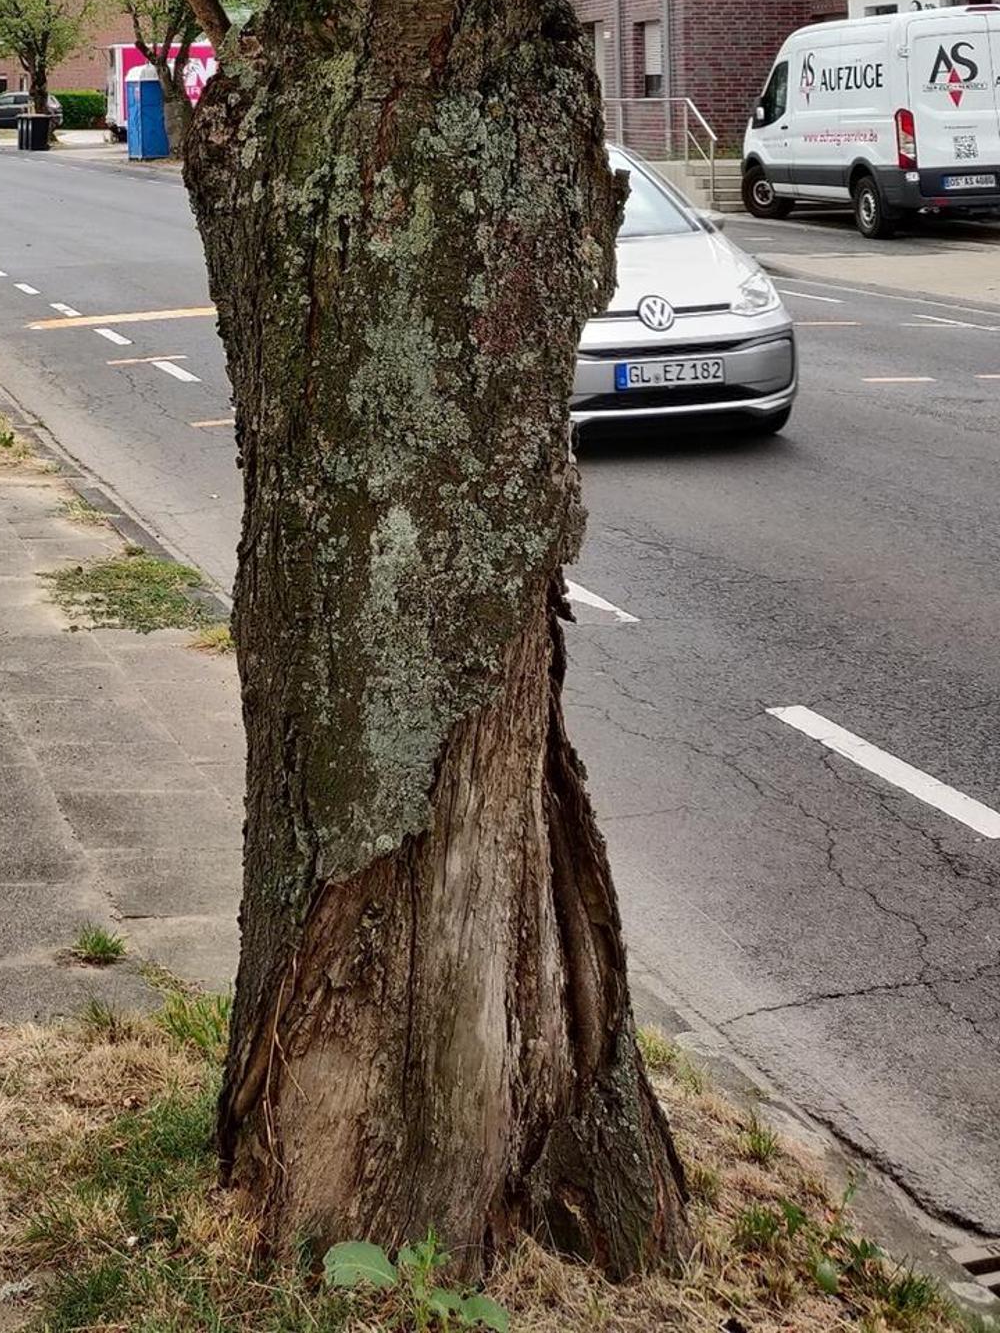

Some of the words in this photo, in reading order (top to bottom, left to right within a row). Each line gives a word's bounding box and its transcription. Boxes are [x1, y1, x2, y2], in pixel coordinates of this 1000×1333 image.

[801, 52, 815, 87] AS
[820, 58, 883, 92] AUFZÜGE
[929, 42, 978, 83] AS
[630, 366, 651, 383] GL
[664, 364, 685, 382] EZ
[691, 361, 722, 380] 182
